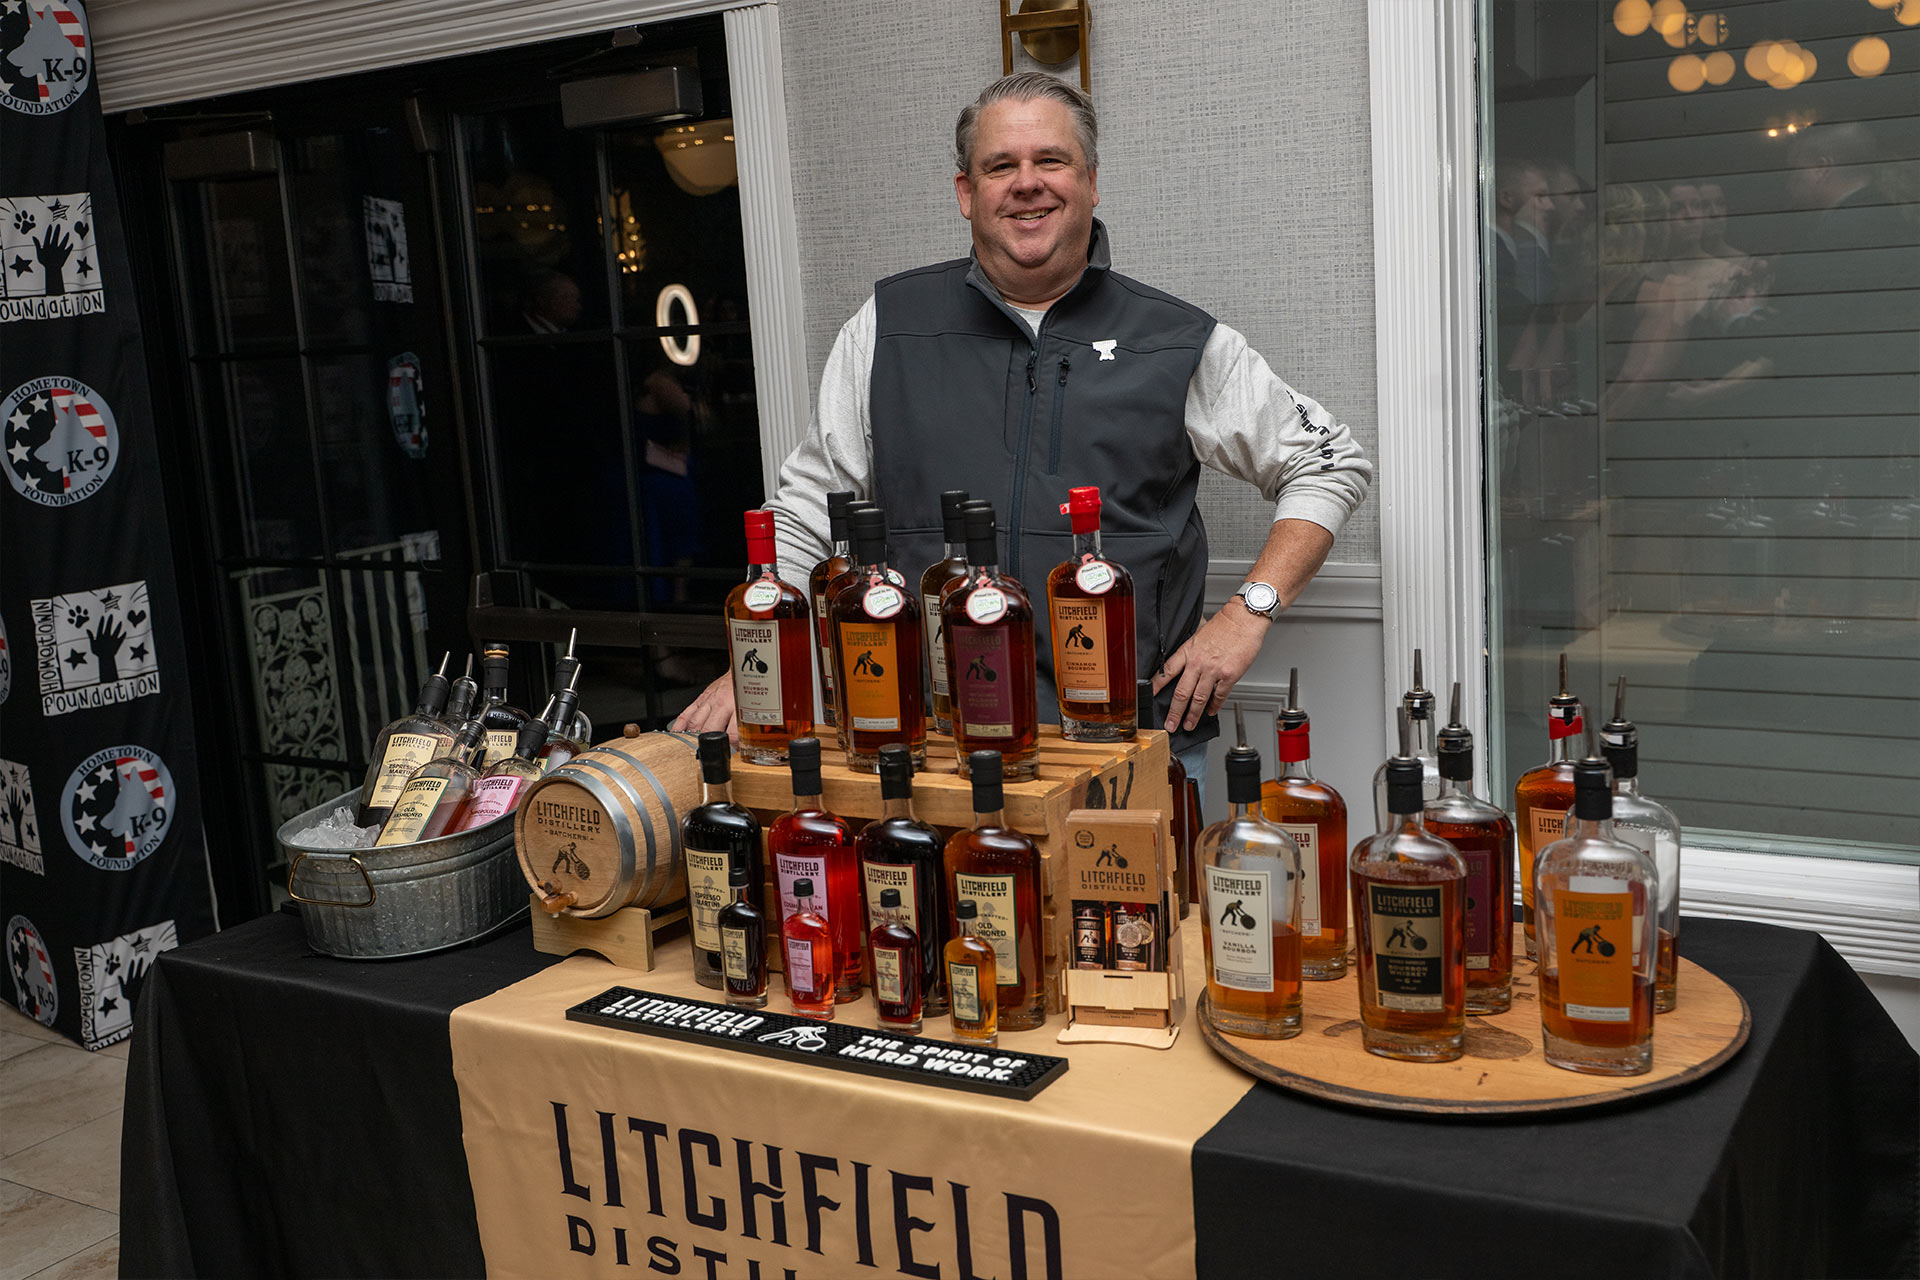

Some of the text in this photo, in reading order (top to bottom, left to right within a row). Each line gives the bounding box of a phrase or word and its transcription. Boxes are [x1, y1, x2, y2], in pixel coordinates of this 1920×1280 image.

[43, 57, 87, 82] K-9
[11, 378, 90, 403] HOMETOWN
[67, 446, 109, 473] K-9
[22, 474, 103, 505] FOUNDATION
[1058, 605, 1097, 616] LITCHFIELD
[735, 627, 772, 638] LITCHFIELD
[846, 631, 888, 642] LITCHFIELD
[393, 736, 432, 747] LITCHFIELD
[77, 747, 154, 776] HOMETOWN
[407, 780, 442, 789] LITCHFIELD
[537, 801, 600, 825] LITCHFIELD
[130, 807, 167, 838] K-9
[537, 817, 601, 834] DISTILLERY
[89, 835, 161, 869] FOUNDATION
[688, 853, 723, 867] LITCHFIELD
[689, 863, 723, 871] DISTILLERY
[780, 859, 819, 872] LITCHFIELD
[781, 868, 819, 876] DISTILLERY
[867, 867, 907, 881] LITCHFIELD
[1081, 870, 1146, 886] LITCHFIELD
[868, 877, 907, 886] DISTILLERY
[961, 879, 1007, 892] LITCHFIELD
[1081, 883, 1146, 893] DISTILLERY
[1213, 875, 1262, 891] LITCHFIELD
[695, 891, 721, 901] ESPRESSO
[962, 889, 1007, 897] DISTILLERY
[1213, 886, 1262, 897] DISTILLERY
[696, 899, 720, 907] MARTINI
[1377, 894, 1434, 908] LITCHFIELD
[1378, 905, 1434, 914] DISTILLERY
[977, 922, 993, 930] OLD
[1222, 945, 1257, 954] BOURBON
[1223, 941, 1255, 949] VANILLA
[37, 985, 55, 1012] K-9
[611, 995, 764, 1031] LITCHFIELD
[600, 1007, 743, 1037] DISTILLERY
[838, 1044, 918, 1067] HARD
[858, 1035, 1027, 1070] THE SPIRIT OF
[550, 1100, 1062, 1280] LITCHFIELD
